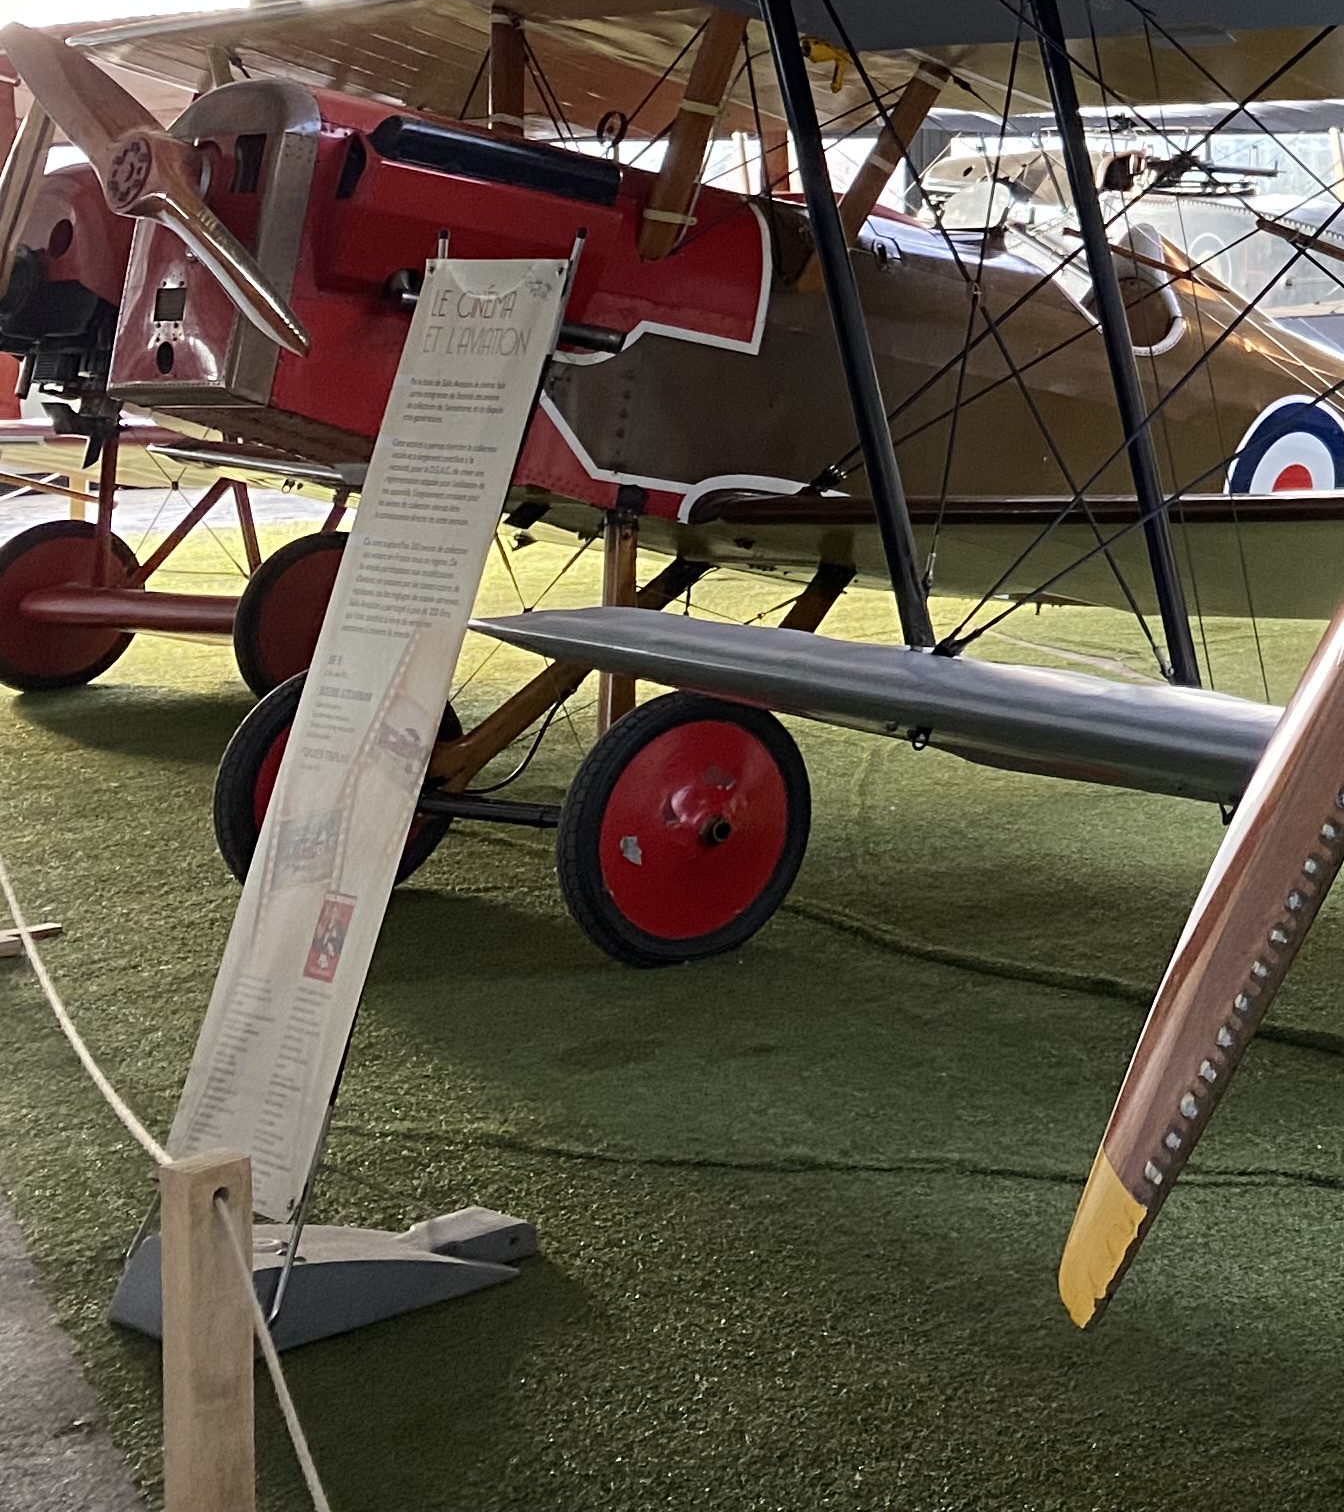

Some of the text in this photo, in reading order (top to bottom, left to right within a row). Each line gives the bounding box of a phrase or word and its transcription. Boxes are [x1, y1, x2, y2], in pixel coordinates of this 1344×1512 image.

[431, 284, 518, 320] LE CINÉMA
[422, 325, 532, 356] ET L'AVIATION
